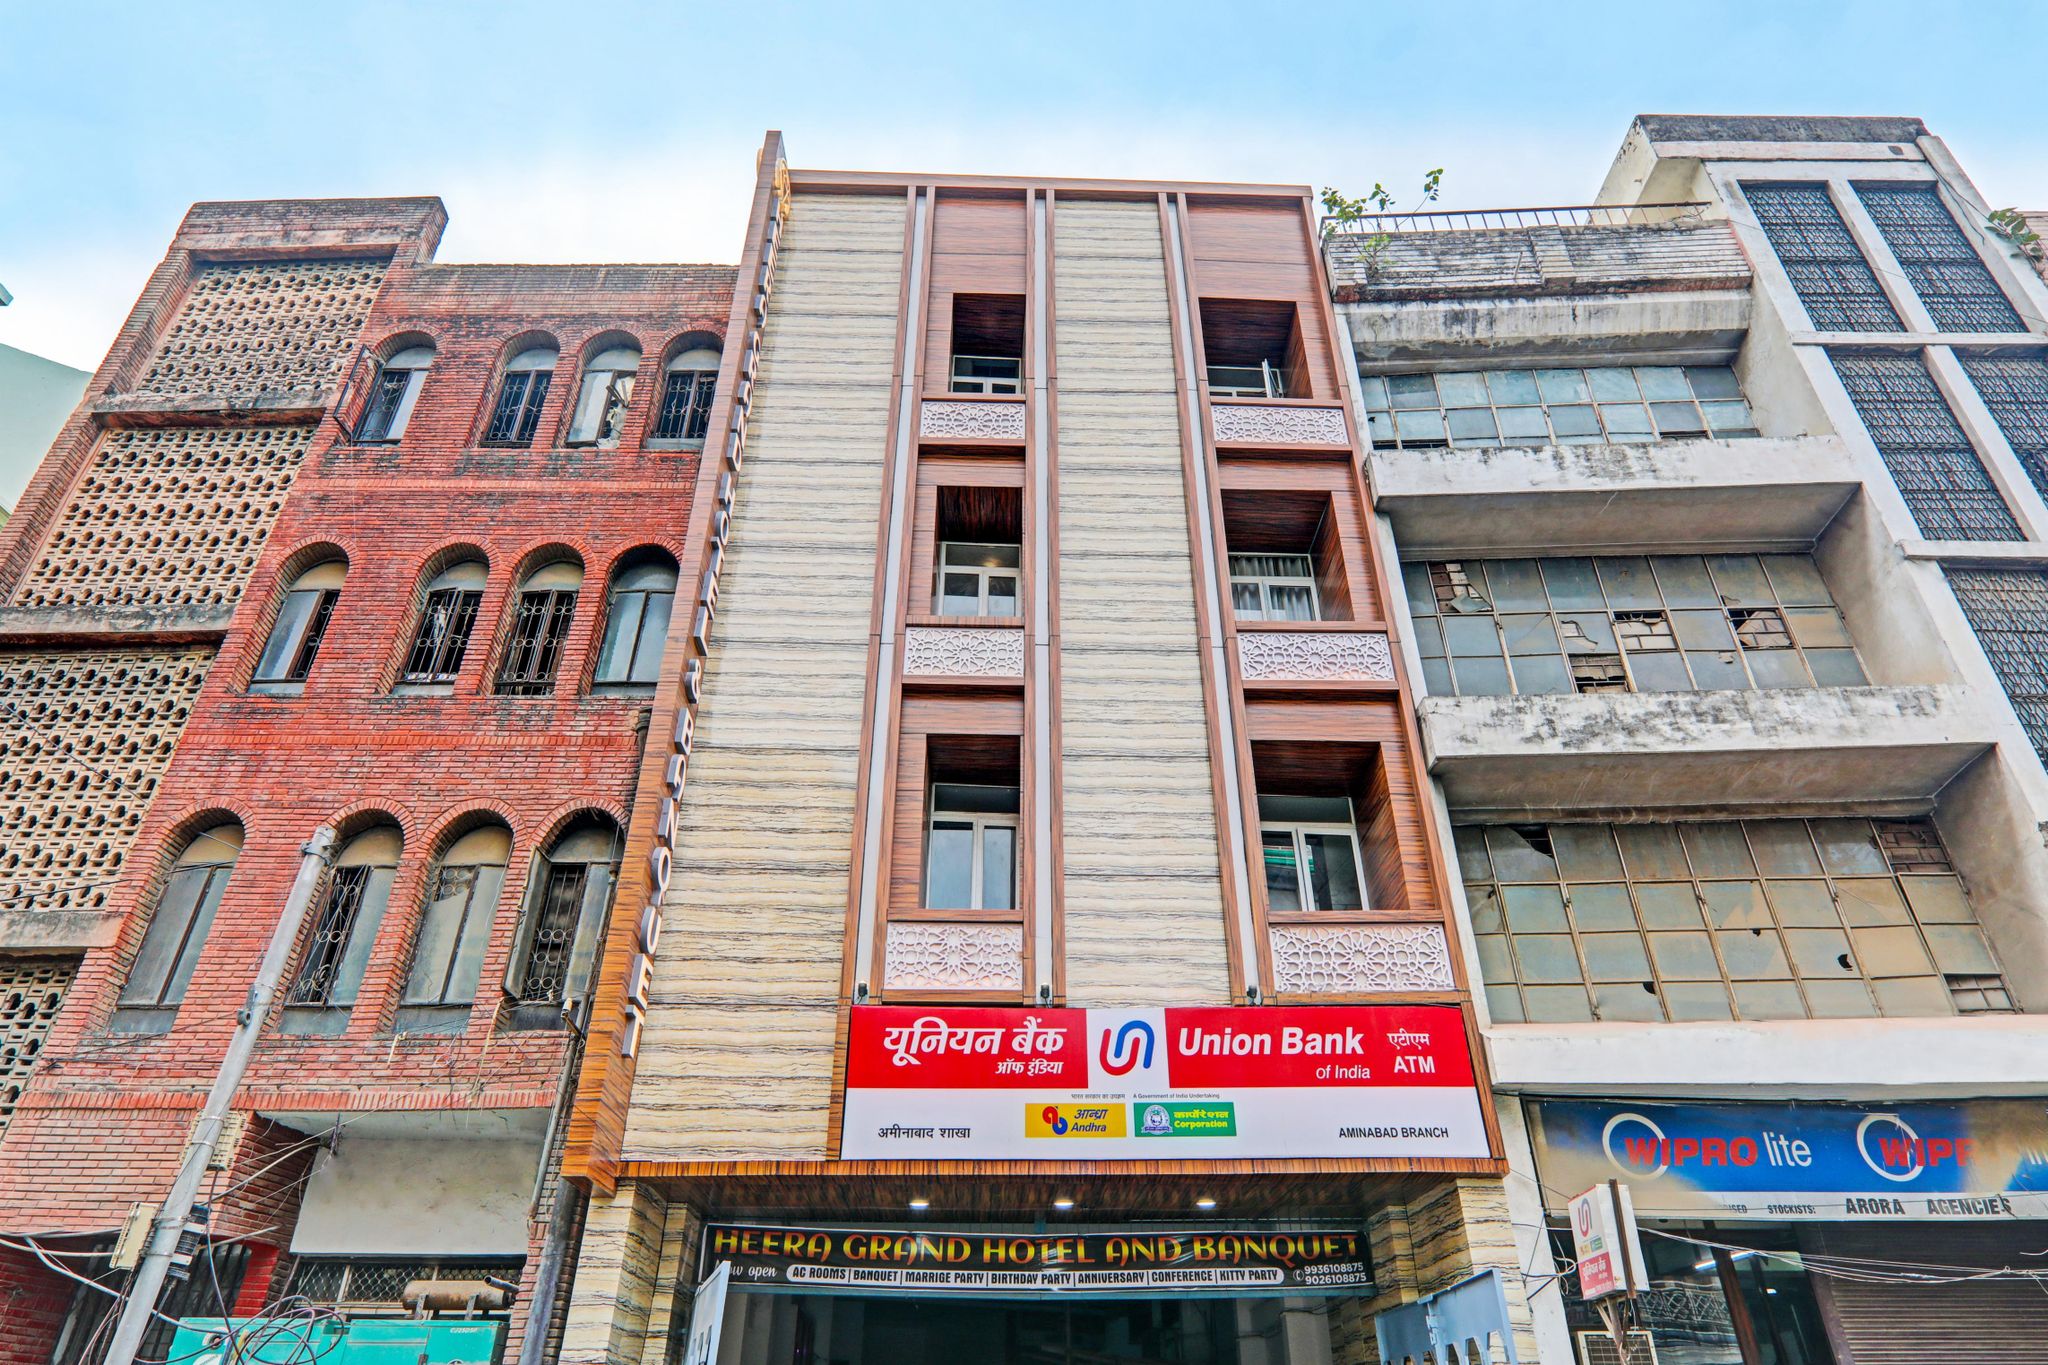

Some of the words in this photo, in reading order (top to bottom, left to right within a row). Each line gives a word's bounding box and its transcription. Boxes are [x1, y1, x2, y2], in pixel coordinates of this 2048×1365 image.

[727, 330, 761, 472] GRAND
[693, 471, 736, 657] HOTEL
[685, 658, 702, 704] &
[621, 707, 693, 1060] BANQUET
[883, 1016, 1006, 1067] यूनियन
[1011, 1015, 1067, 1055] बैंक
[1178, 1027, 1271, 1056] Union
[1281, 1026, 1364, 1055] Bank
[1386, 1028, 1430, 1050] एटीएम
[995, 1058, 1025, 1075] ऑफ
[1026, 1058, 1064, 1077] इंडिया
[1316, 1065, 1331, 1079] of
[1334, 1065, 1371, 1079] India
[1393, 1055, 1436, 1074] ATM
[877, 1123, 934, 1140] अमीनाबाद
[940, 1126, 971, 1140] शाखा
[1071, 1122, 1107, 1133] Andhra
[1174, 1120, 1228, 1130] Corporation
[1339, 1127, 1399, 1139] AMINABAD
[1401, 1127, 1449, 1138] BRANCH
[1624, 1136, 1758, 1167] WIPRO
[1762, 1131, 1813, 1167] lite
[1767, 1204, 1817, 1215] STOCKISTS:
[1845, 1198, 1906, 1215] ARORA
[1927, 1197, 2012, 1215] AGENCIES
[713, 1229, 832, 1263] HEERA
[843, 1234, 971, 1266] GRAND
[983, 1237, 1095, 1265] HOTEL
[1105, 1236, 1182, 1267] AND
[1193, 1234, 1358, 1268] BANQUET
[747, 1266, 778, 1281] open
[792, 1266, 807, 1279] AC
[810, 1267, 846, 1280] ROOMS
[853, 1270, 898, 1283] BANQUET
[905, 1271, 951, 1283] MARRIGE
[954, 1272, 984, 1284] PARTY
[991, 1273, 1038, 1285] BIRTHDAY
[1041, 1273, 1072, 1285] PARTY
[1078, 1272, 1144, 1284] ANNIVERSARY
[1152, 1270, 1213, 1283] CONFERENCE
[1220, 1270, 1245, 1281] KITTY
[1249, 1269, 1278, 1281] PARTY
[1304, 1262, 1364, 1274] 9936108875
[1305, 1272, 1367, 1285] 9026108875
